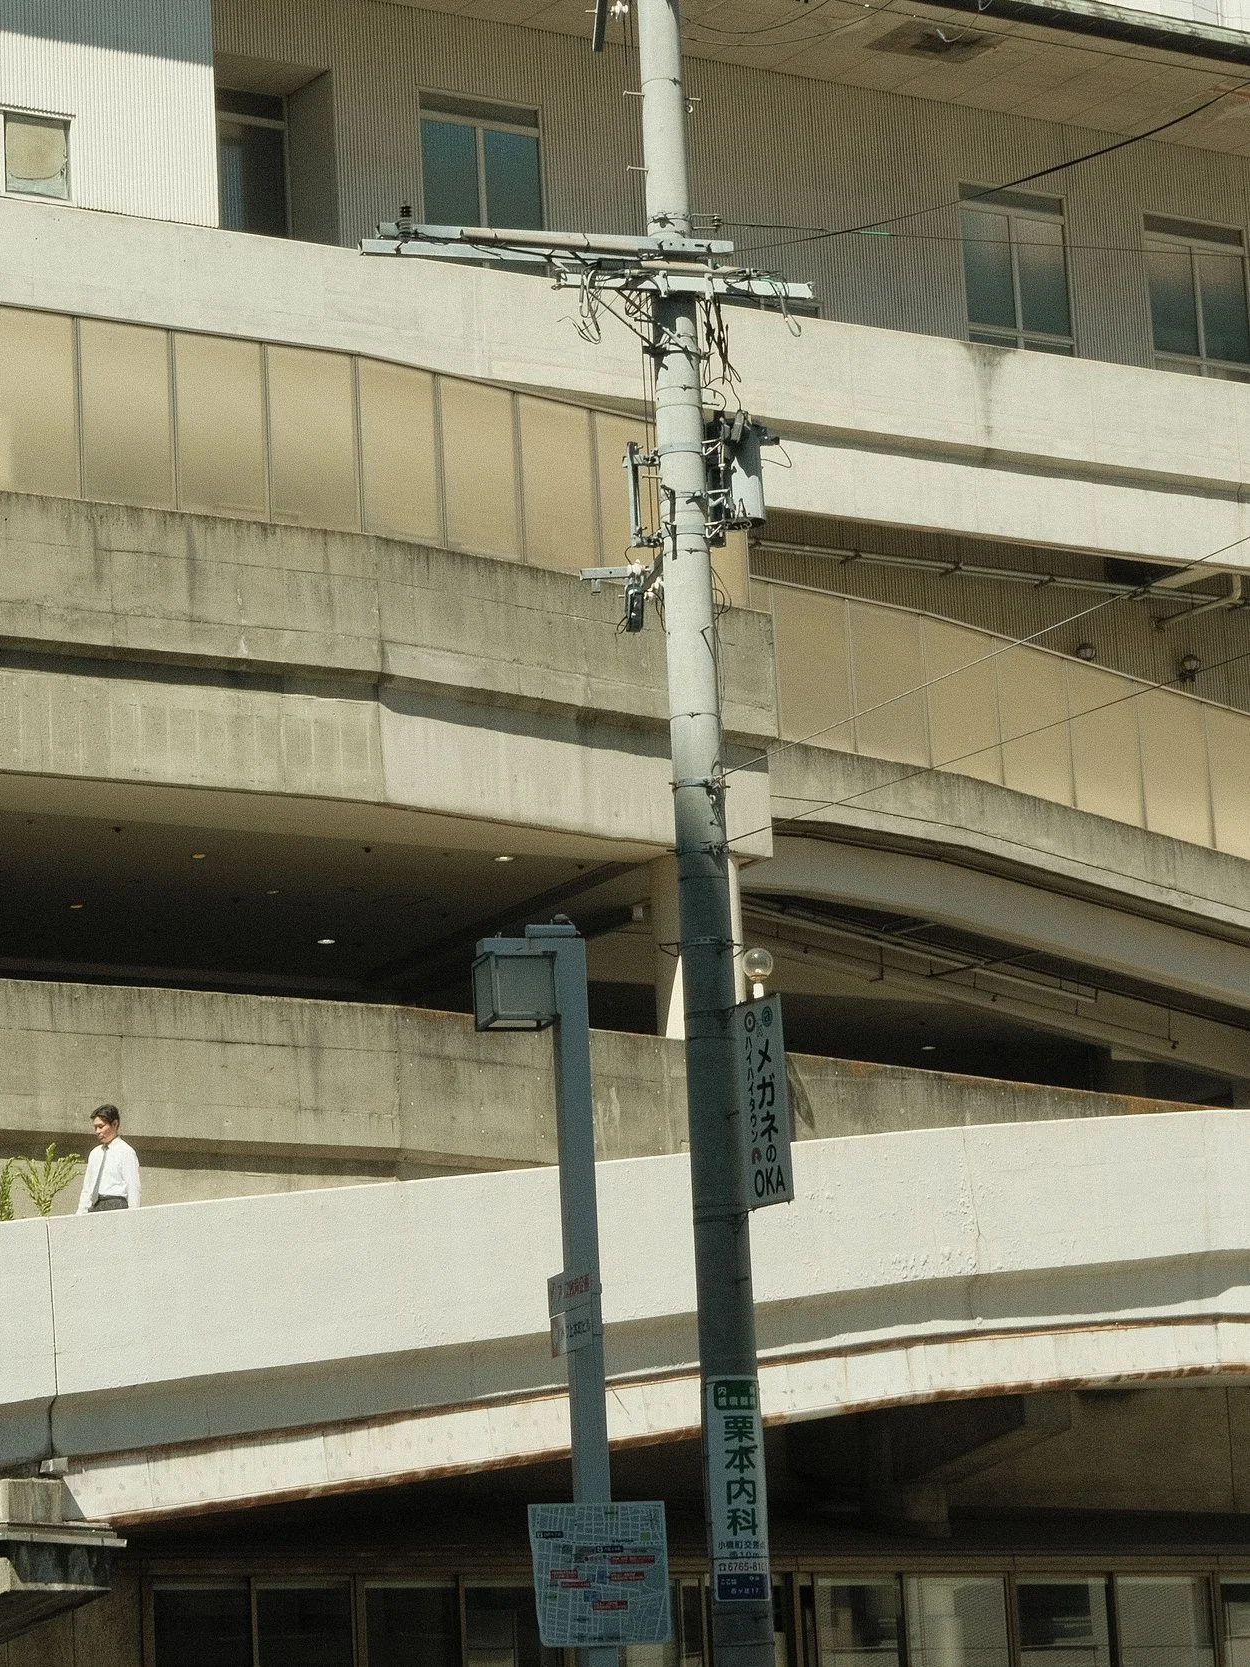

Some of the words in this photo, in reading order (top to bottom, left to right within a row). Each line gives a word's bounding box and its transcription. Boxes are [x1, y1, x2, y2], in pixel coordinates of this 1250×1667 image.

[745, 1036, 758, 1143] ハイハイタウン
[757, 1038, 779, 1163] メガネの
[754, 1164, 786, 1198] OKA
[723, 1415, 758, 1537] 栗本内科
